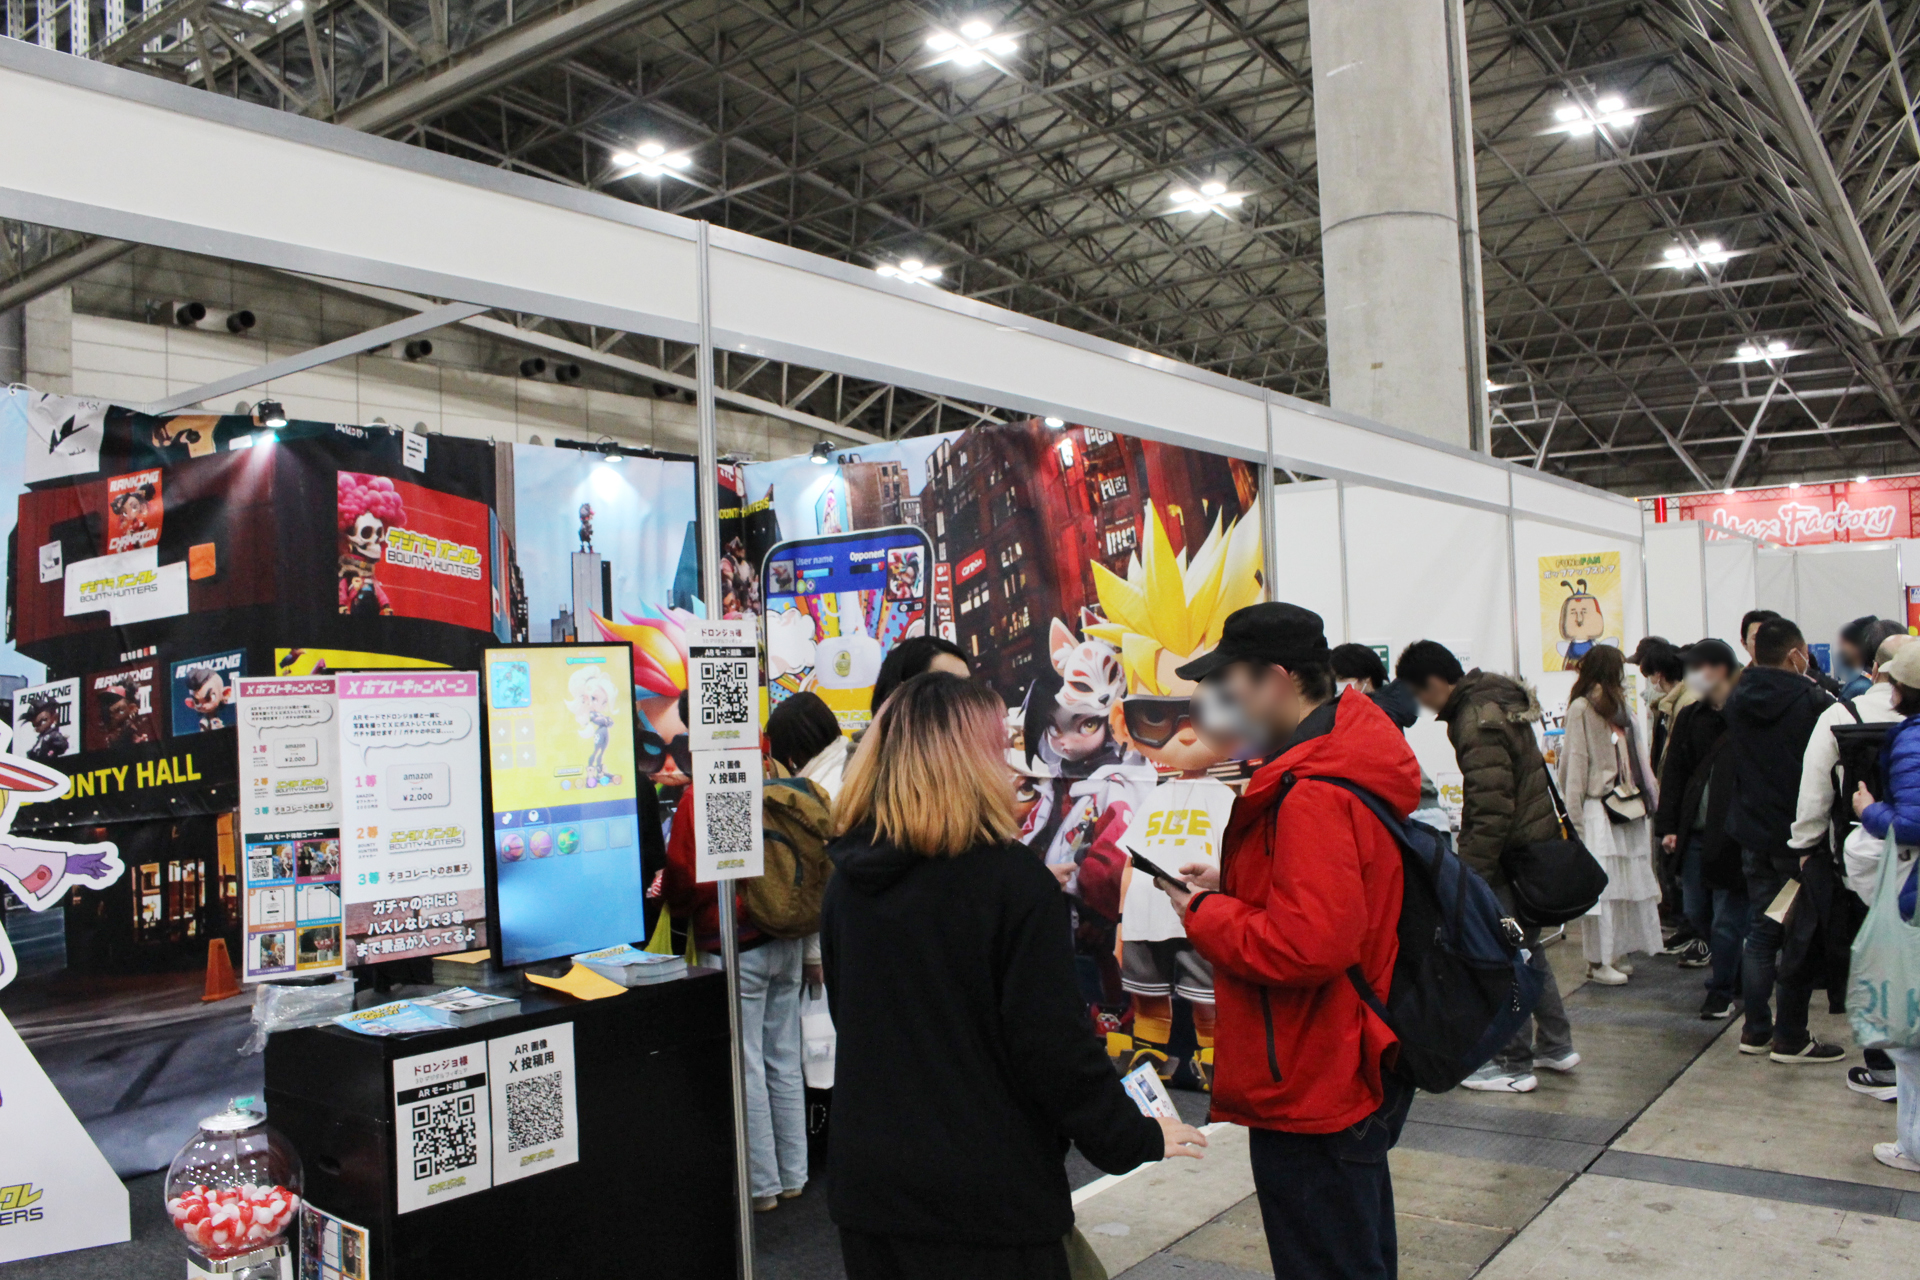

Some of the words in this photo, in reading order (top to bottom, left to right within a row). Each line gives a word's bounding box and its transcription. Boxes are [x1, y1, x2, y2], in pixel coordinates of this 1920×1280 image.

[109, 470, 159, 492] RANKING
[1778, 501, 1897, 545] Factory
[387, 550, 432, 565] BOUNTY
[434, 560, 480, 578] HUNTERS
[813, 555, 834, 564] name
[850, 548, 885, 562] Opponent
[1543, 565, 1616, 579] ポップアップストア
[79, 591, 113, 603] BOUNTY
[113, 583, 158, 599] HUNTERS
[19, 684, 72, 706] RANKING
[361, 679, 469, 695] ポストキャンペーン
[136, 753, 202, 789] HALL
[714, 761, 725, 769] AR
[403, 772, 433, 780] amazon
[709, 773, 716, 784] X
[719, 771, 747, 784] 投稿用
[1145, 809, 1212, 838] SGE
[389, 841, 423, 851] BOUNTY
[424, 837, 462, 847] HUNTERS
[388, 863, 469, 881] チョコレートのお菓子
[373, 892, 458, 916] ガチャの中には
[367, 910, 465, 936] ハズレなしで3等
[356, 927, 476, 957] まで景品が入ってるよ
[515, 1043, 528, 1055] AR
[531, 1038, 548, 1052] 画像
[414, 1055, 468, 1076] ドロンジョ様
[509, 1059, 518, 1073] X
[521, 1050, 555, 1071] 投稿用
[418, 1088, 431, 1099] AR
